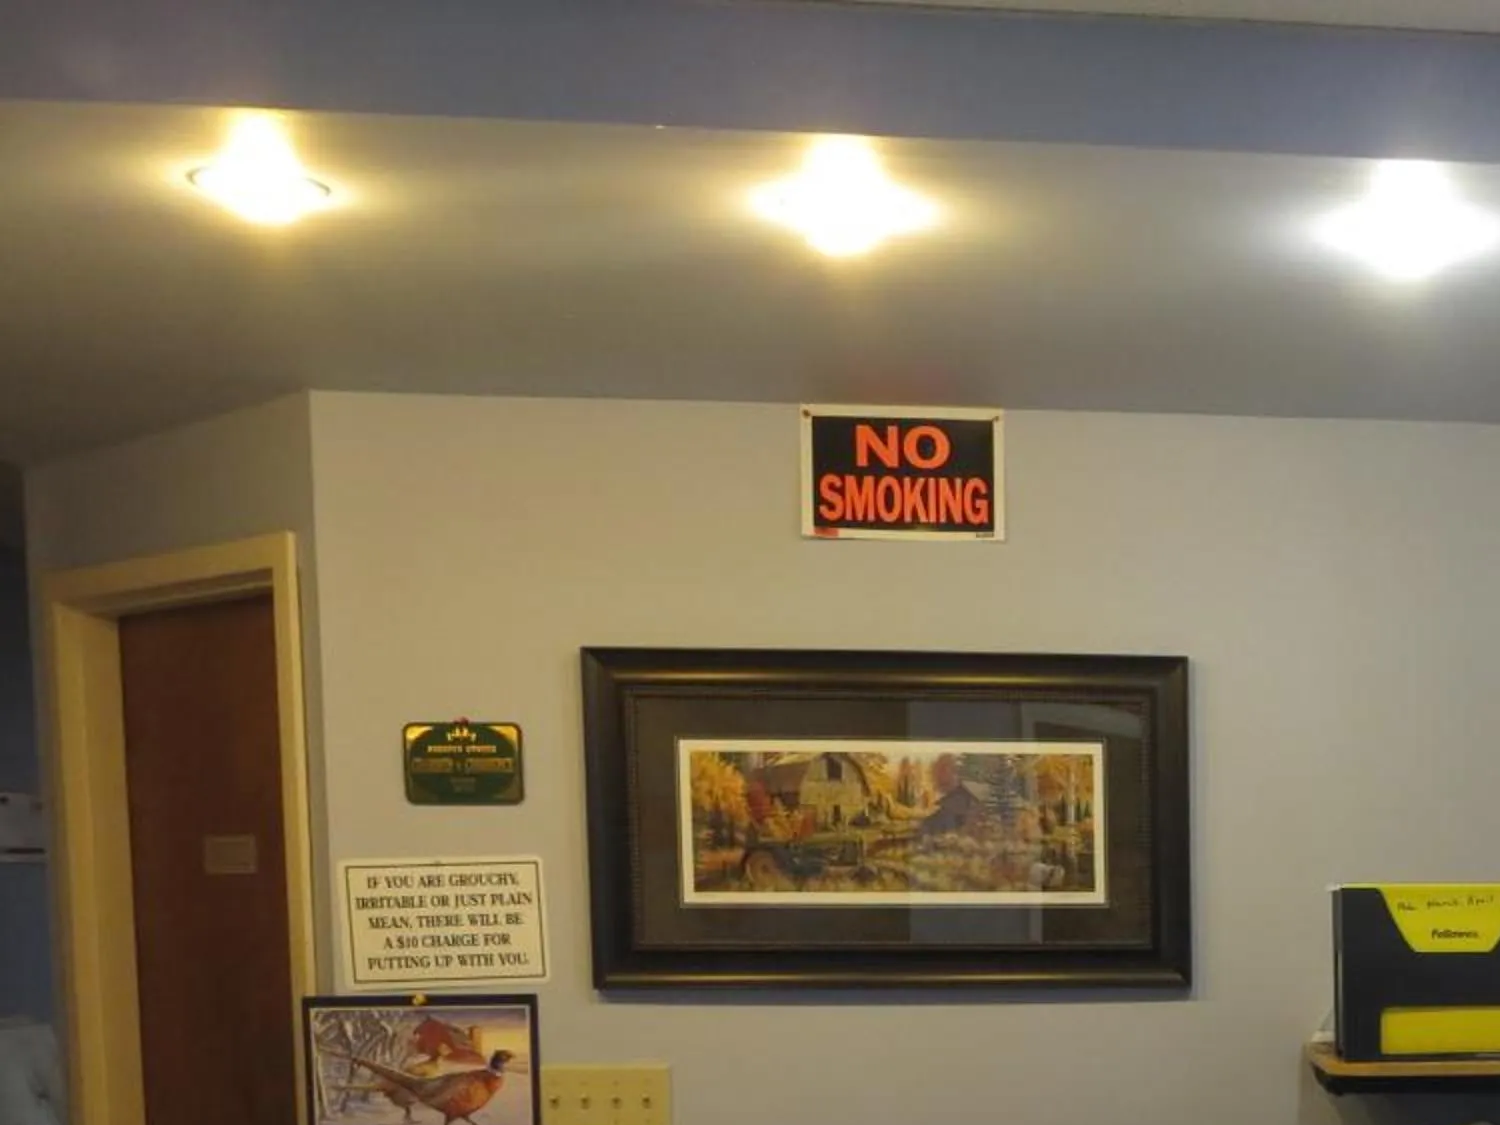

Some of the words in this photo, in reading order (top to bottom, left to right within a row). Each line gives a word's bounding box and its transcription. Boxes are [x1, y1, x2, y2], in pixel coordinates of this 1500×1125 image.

[855, 424, 950, 469] NO
[819, 473, 988, 524] SMOKING
[367, 876, 380, 889] IF
[384, 875, 414, 889] YOU
[417, 874, 444, 888] ARE
[355, 894, 426, 910] IRRITABLE
[431, 894, 450, 907] OR
[454, 893, 487, 908] JUST
[490, 892, 532, 906] PLAIN
[416, 914, 463, 928] THERE
[467, 913, 502, 926] WILL
[506, 912, 524, 925] BE
[384, 937, 394, 950] A
[396, 935, 419, 950] $10
[421, 934, 480, 948] CHARGE
[483, 933, 511, 946] FOR
[367, 956, 431, 971] PUTTING
[434, 954, 453, 968] UP
[457, 953, 495, 967] WITH
